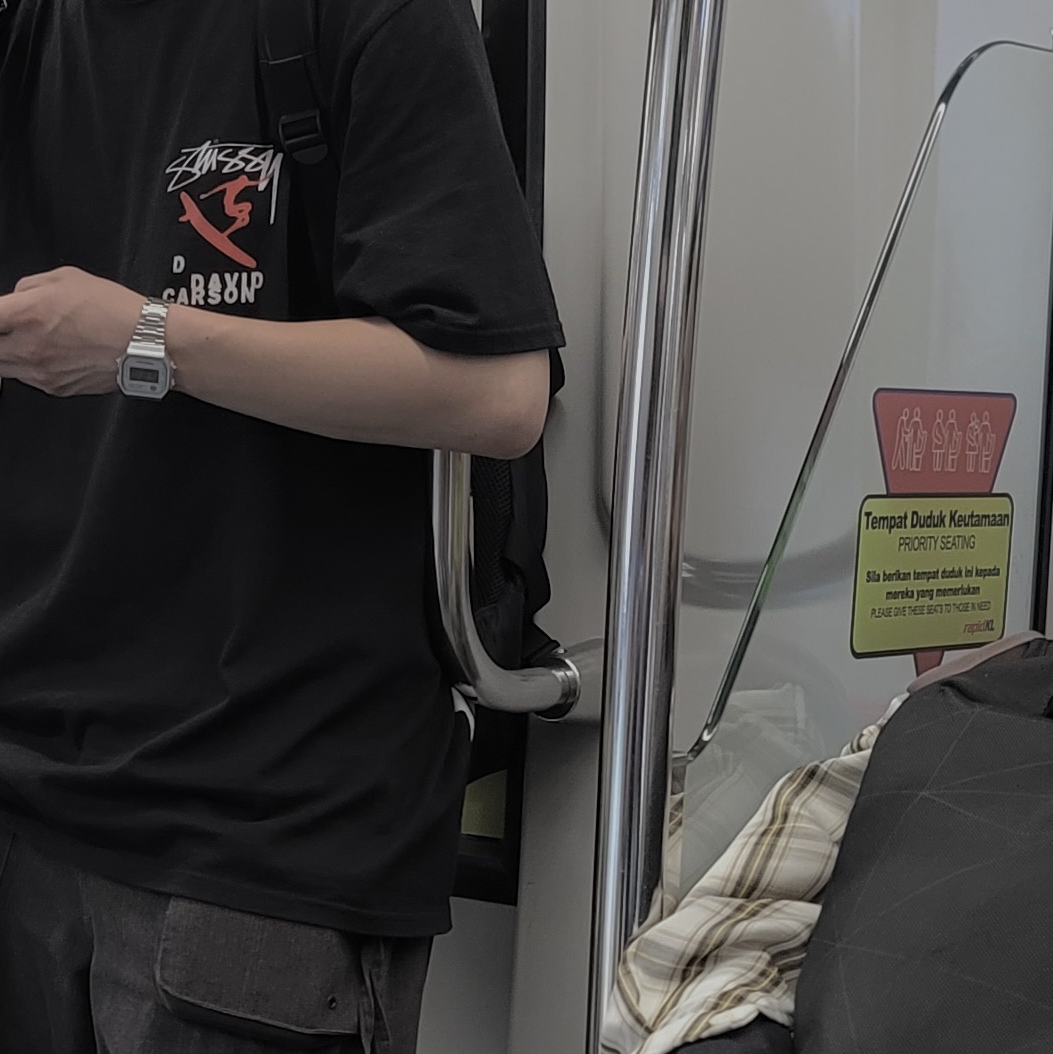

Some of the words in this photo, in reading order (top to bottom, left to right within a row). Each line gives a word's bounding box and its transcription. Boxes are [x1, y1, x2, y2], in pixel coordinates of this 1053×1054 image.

[173, 255, 185, 273] D
[162, 287, 255, 305] CARSON
[864, 511, 908, 534] Tempat
[911, 510, 946, 528] Duduk
[949, 510, 1009, 528] Keutamaan
[898, 536, 939, 551] PRIORITY
[940, 535, 975, 550] SEATING
[866, 570, 880, 583] Sila
[883, 569, 911, 581] berikan
[913, 569, 939, 582] tempat
[941, 567, 962, 579] duduk
[965, 566, 974, 578] ini
[975, 566, 1000, 580] kepada
[886, 587, 914, 600] mereka
[916, 588, 934, 601] yang
[936, 584, 980, 597] memerlukan
[871, 608, 892, 618] PLEASE
[894, 607, 907, 617] GIVE
[908, 606, 925, 616] THESE
[926, 604, 943, 615] SEATS
[944, 603, 951, 613] TO
[952, 602, 970, 613] THOSE
[976, 601, 991, 611] NEED
[963, 620, 995, 635] rapidKL
